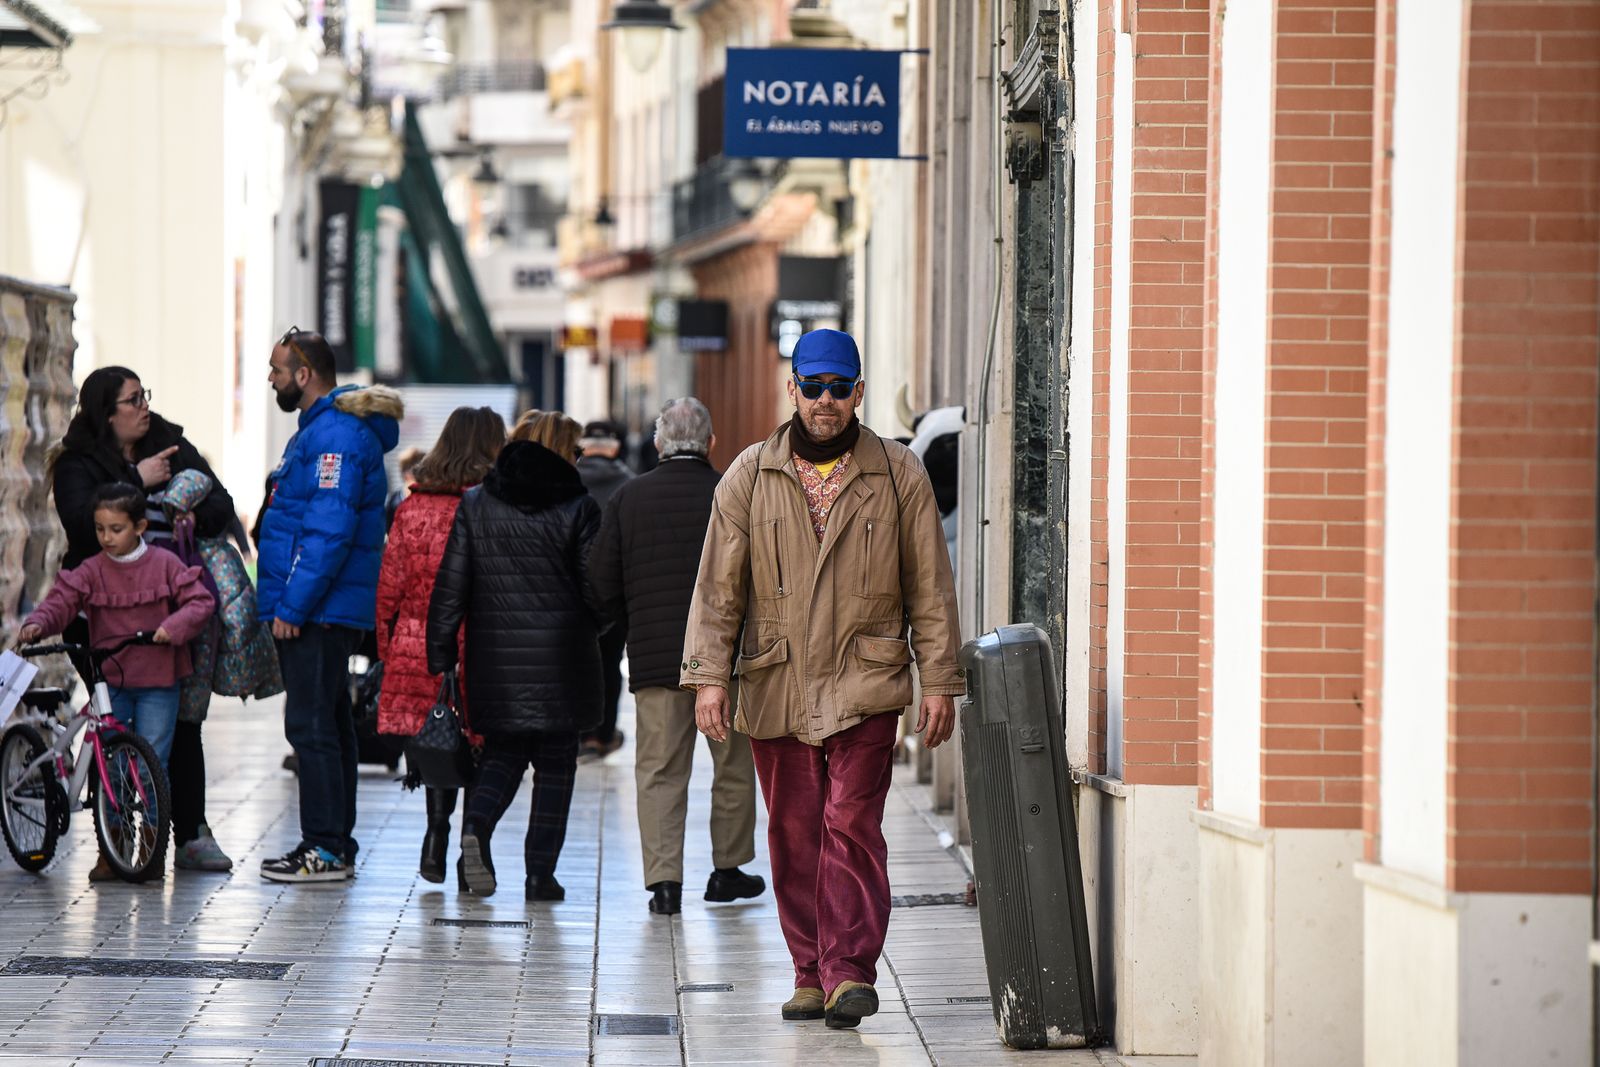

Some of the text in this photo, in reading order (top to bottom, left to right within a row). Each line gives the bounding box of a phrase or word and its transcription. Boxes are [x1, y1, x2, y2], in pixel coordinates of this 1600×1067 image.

[744, 75, 885, 106] NOTARÍA
[766, 115, 822, 134] ÁBALOS
[829, 120, 883, 134] NUEVO
